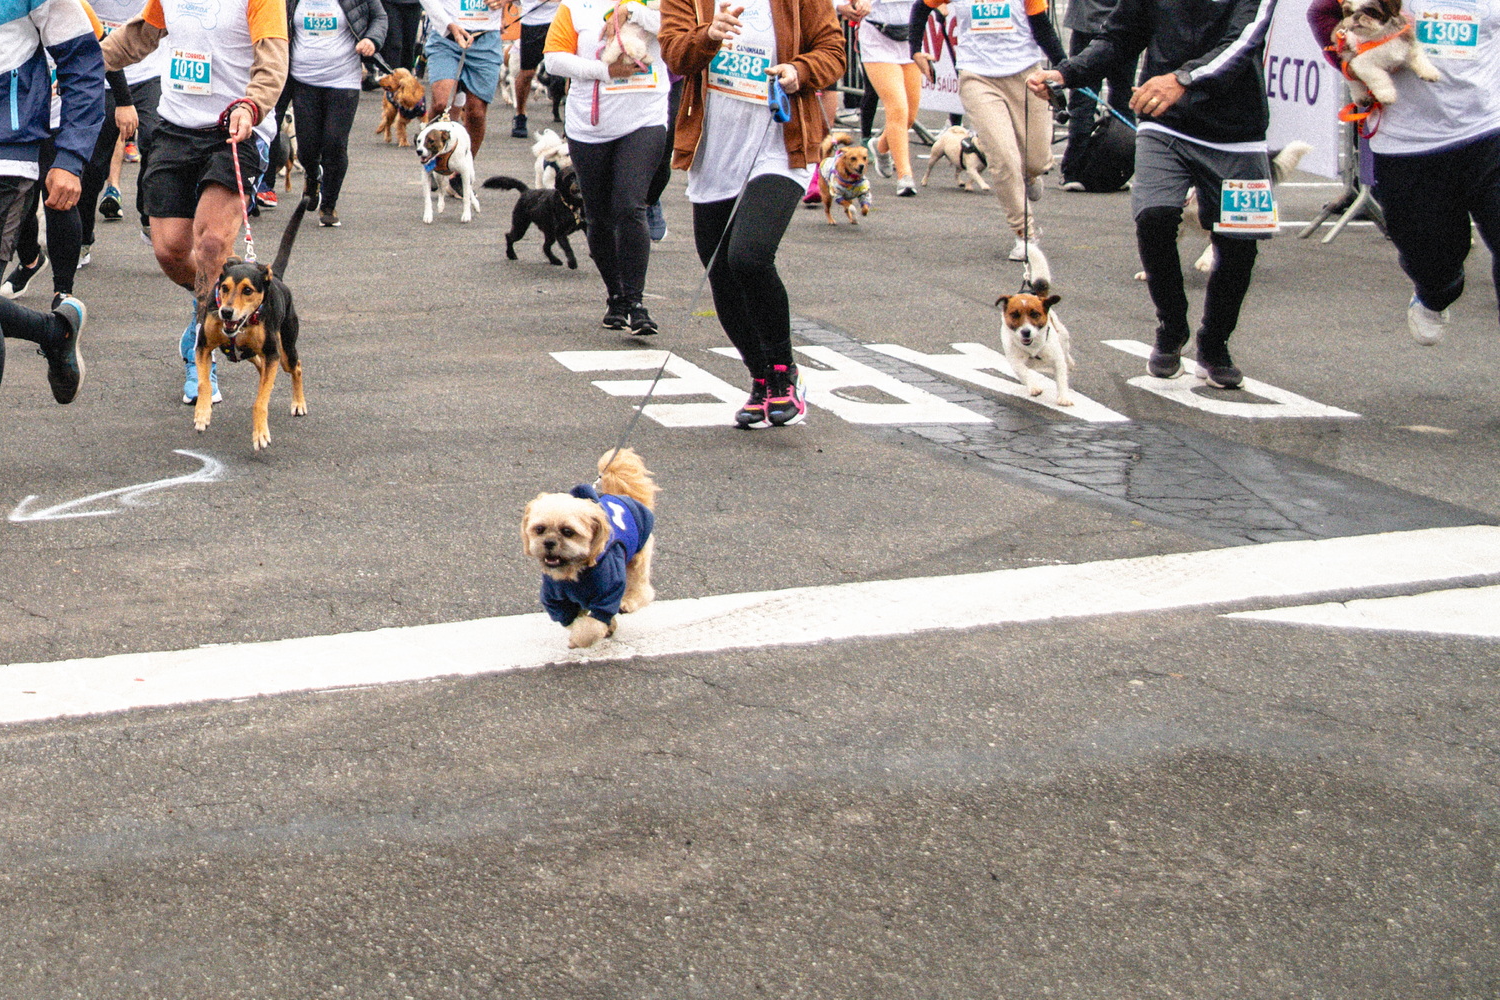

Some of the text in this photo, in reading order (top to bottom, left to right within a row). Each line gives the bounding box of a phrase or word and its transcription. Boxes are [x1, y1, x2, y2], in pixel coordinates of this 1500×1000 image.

[977, 4, 1004, 17] 1367
[1443, 13, 1472, 21] CORRIDA
[307, 17, 334, 29] 1323
[1423, 22, 1471, 41] 1309
[185, 51, 206, 60] CORRIDA
[736, 44, 766, 56] CAMINHADA
[174, 59, 205, 80] 1019
[716, 51, 763, 77] 2388
[937, 74, 959, 94] SAÚD
[1267, 55, 1319, 105] ECTO
[1230, 191, 1269, 208] 1312
